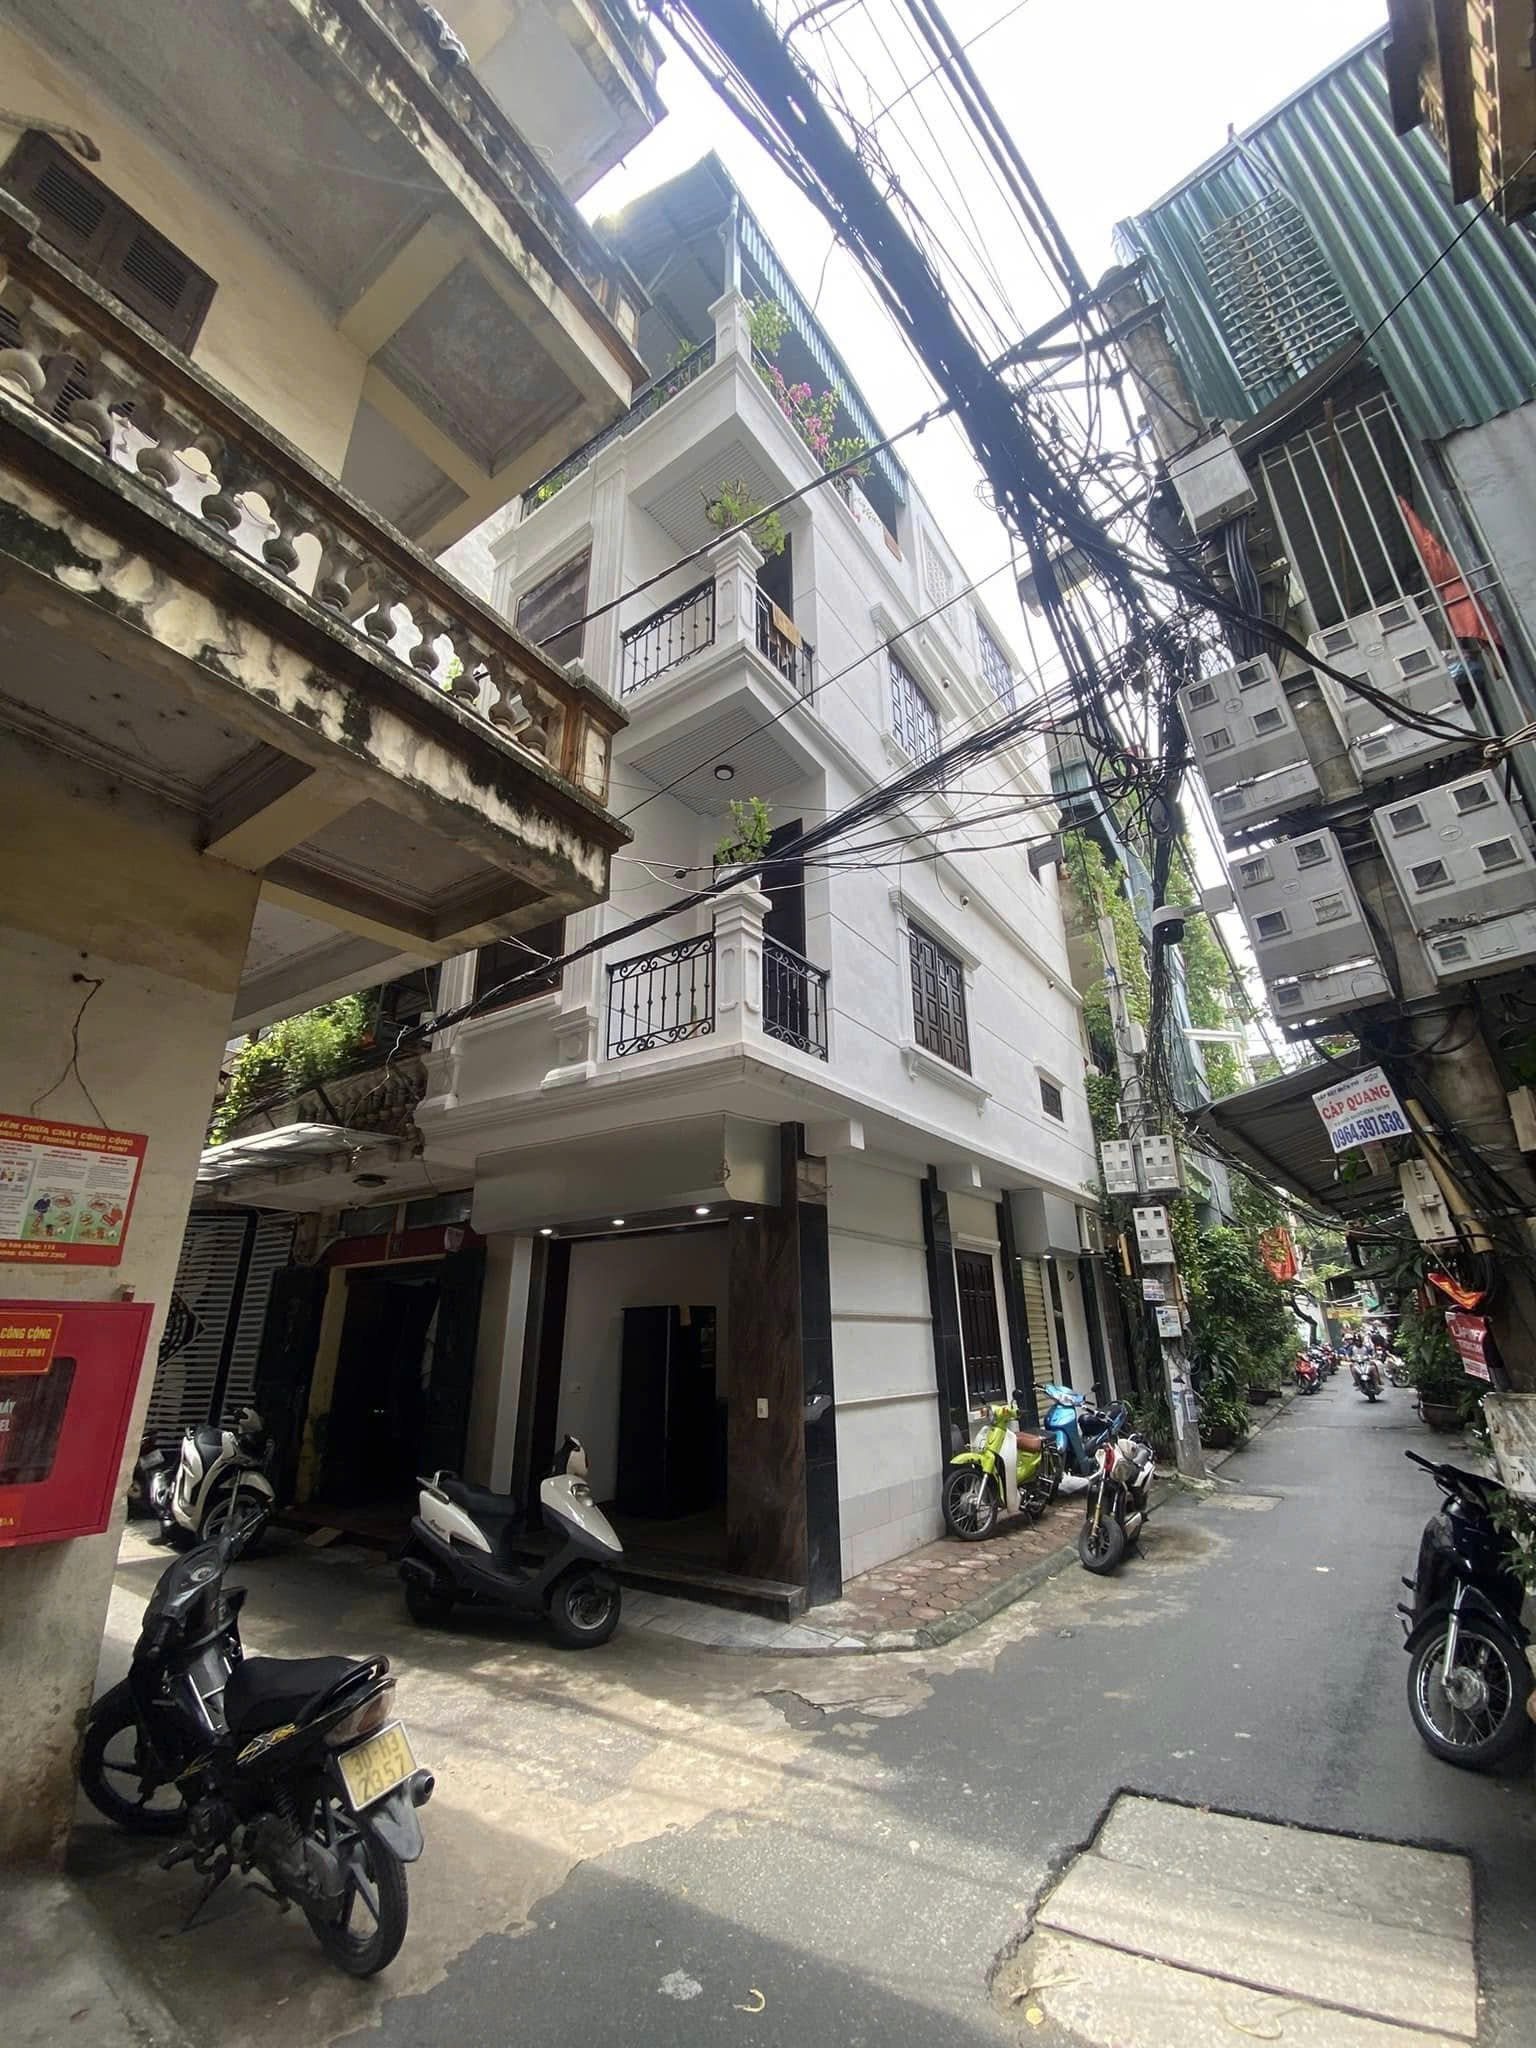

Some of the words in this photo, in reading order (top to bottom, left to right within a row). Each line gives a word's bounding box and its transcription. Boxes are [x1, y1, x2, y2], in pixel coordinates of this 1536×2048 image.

[1322, 1101, 1345, 1120] CÁP
[1347, 1084, 1391, 1112] QUANG
[80, 1132, 107, 1143] CÔNG
[108, 1135, 134, 1147] CỘNG
[1332, 1110, 1405, 1149] 0964.597.638
[0, 1326, 26, 1339] CÔNG
[27, 1326, 52, 1341] CỘNG
